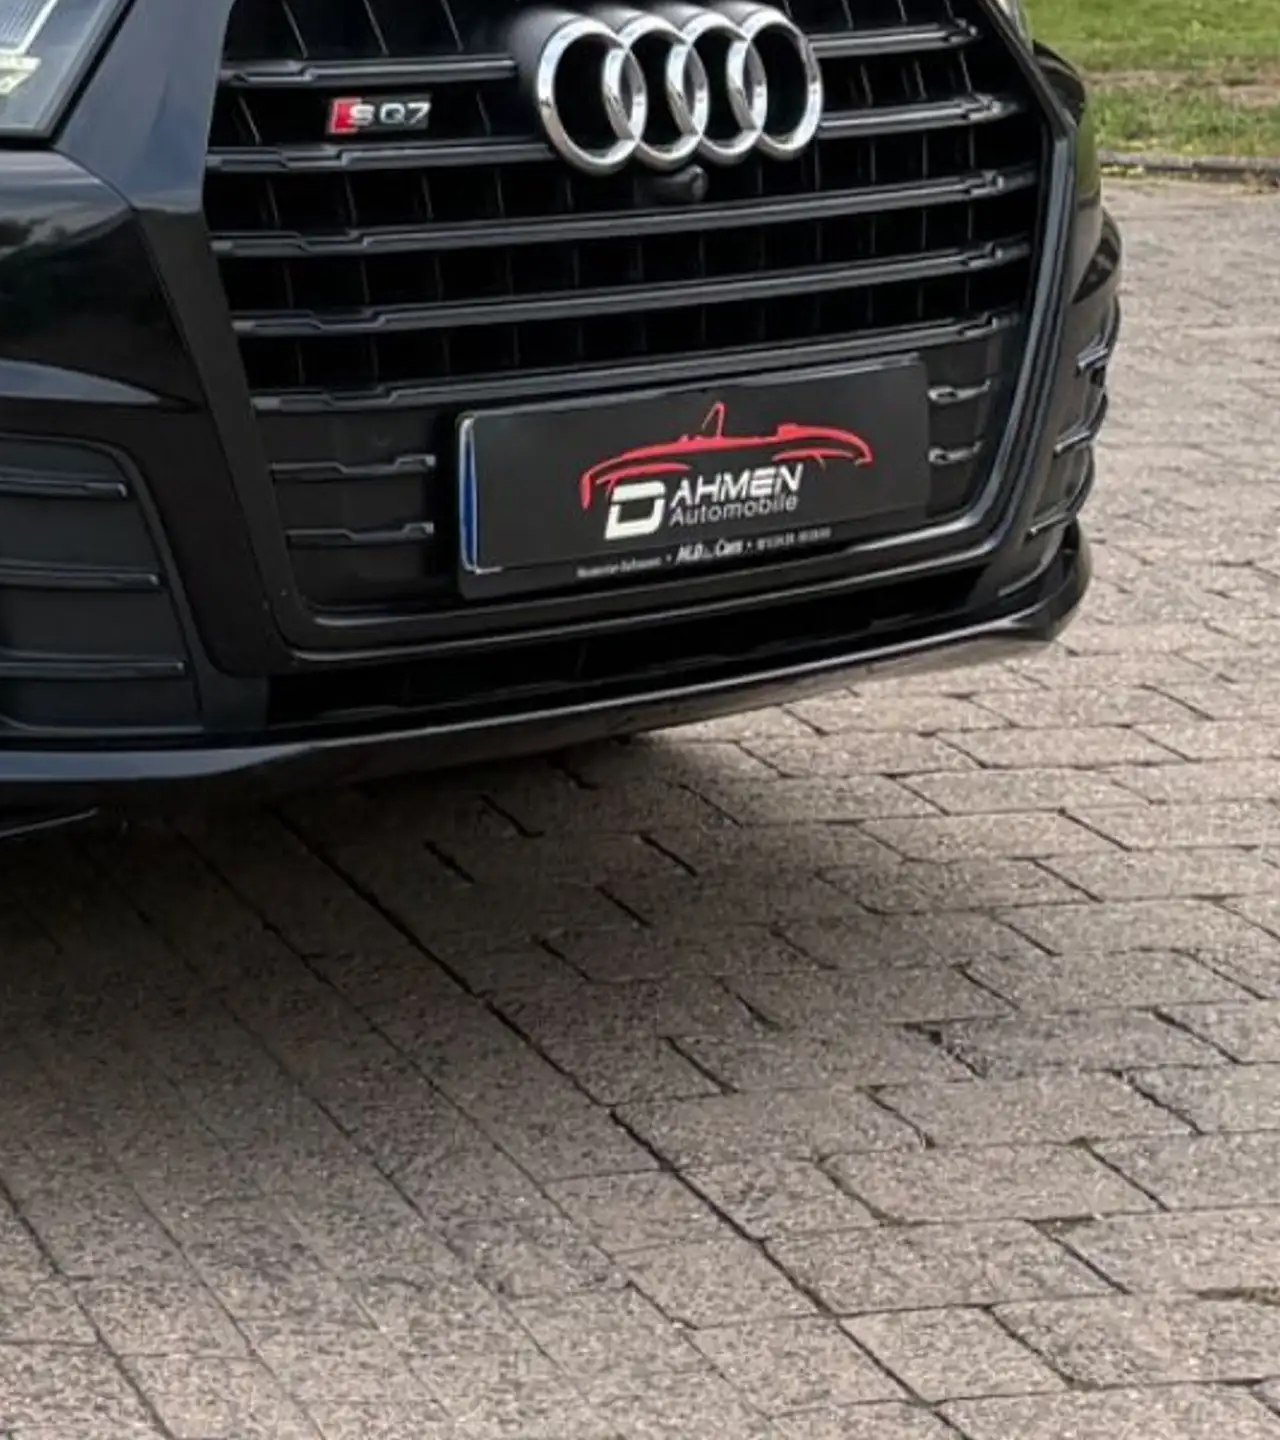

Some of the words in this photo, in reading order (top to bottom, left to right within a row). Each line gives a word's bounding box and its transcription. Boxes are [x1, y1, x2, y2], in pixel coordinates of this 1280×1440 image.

[346, 99, 433, 128] SQ7
[603, 463, 805, 541] DAHMEN
[669, 492, 800, 529] Automobile
